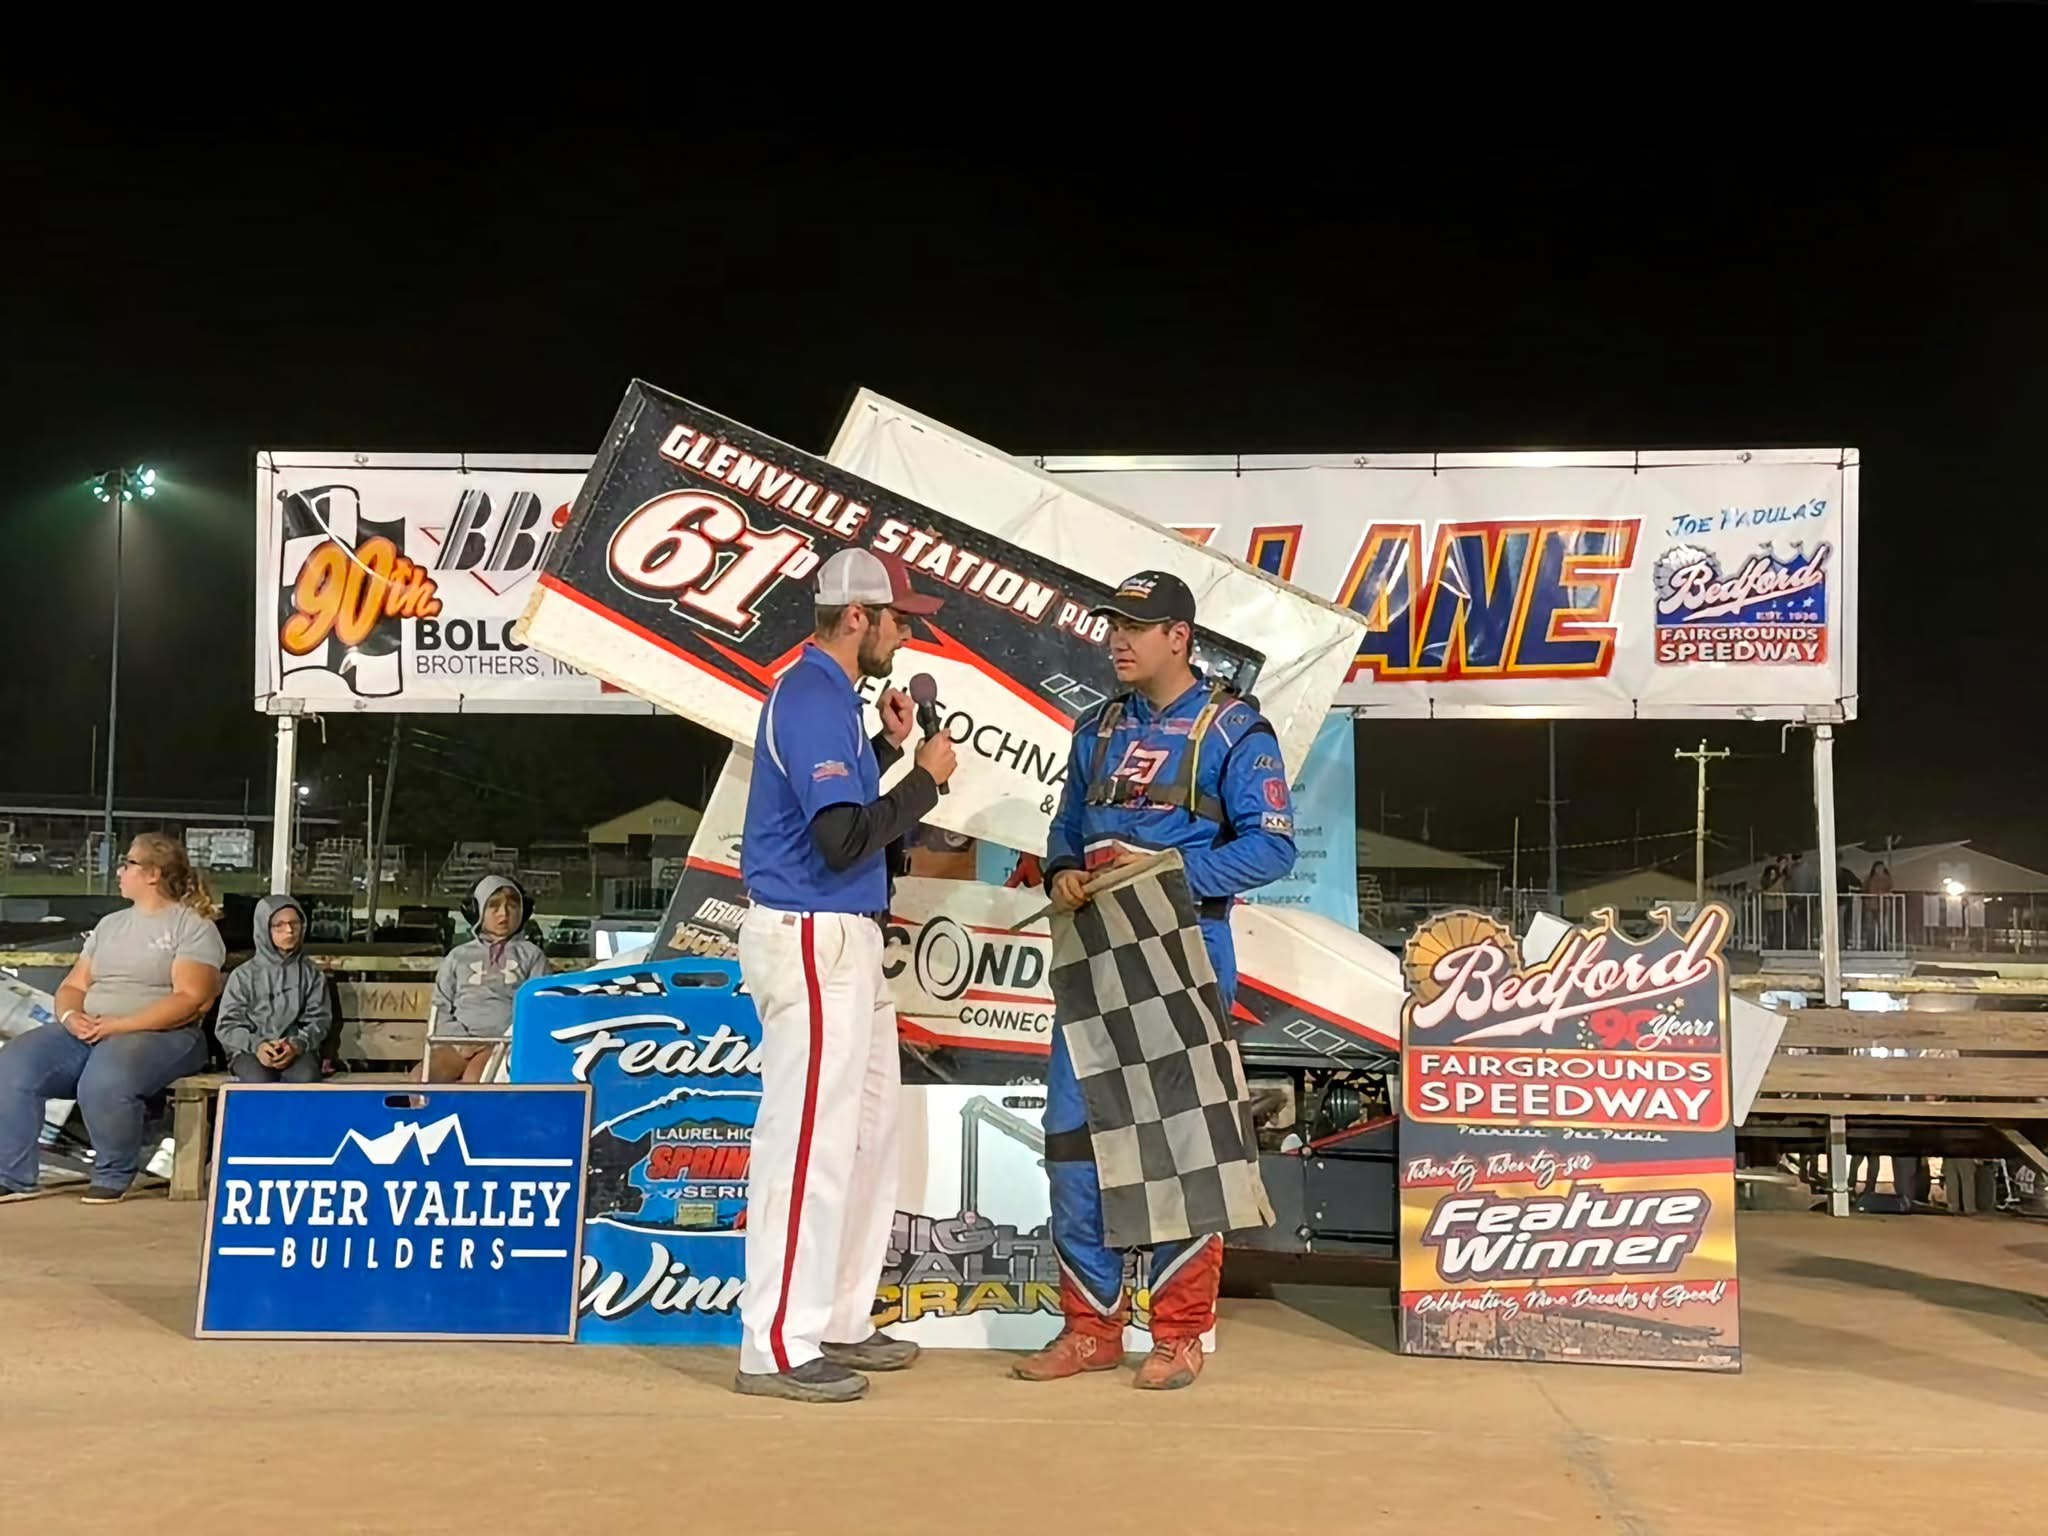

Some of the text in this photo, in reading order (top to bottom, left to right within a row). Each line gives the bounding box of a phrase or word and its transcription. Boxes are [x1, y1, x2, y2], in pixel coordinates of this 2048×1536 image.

[659, 423, 1110, 643] GLENVILLE STATION PUB
[1666, 513, 1713, 536] JOE
[1657, 542, 1830, 616] Bedford
[1659, 641, 1820, 663] SPEEDWAY
[1660, 627, 1819, 641] FAIRGROUNDS
[416, 655, 545, 676] BROTHERS,
[1039, 794, 1055, 817] &
[1412, 910, 1712, 1045] Bedford
[958, 1005, 1055, 1034] CONNEC
[1636, 1013, 1714, 1051] Years
[1420, 1054, 1713, 1083] FAIRGROUNDS
[1419, 1081, 1713, 1121] SPEEDWAY
[656, 1127, 724, 1140] LAUREL
[647, 1143, 752, 1181] SPRIN
[1406, 1155, 1478, 1194] Twenty
[221, 1179, 572, 1229] RIVER VALLEY
[682, 1185, 749, 1199] SERI
[1430, 1190, 1702, 1238] Feature
[280, 1236, 505, 1271] BUILDERS
[1439, 1231, 1688, 1275] Winner
[1414, 1289, 1520, 1321] Celebrating
[1572, 1288, 1639, 1309] Decades
[1639, 1288, 1659, 1312] of
[1661, 1281, 1727, 1308] Speed!
